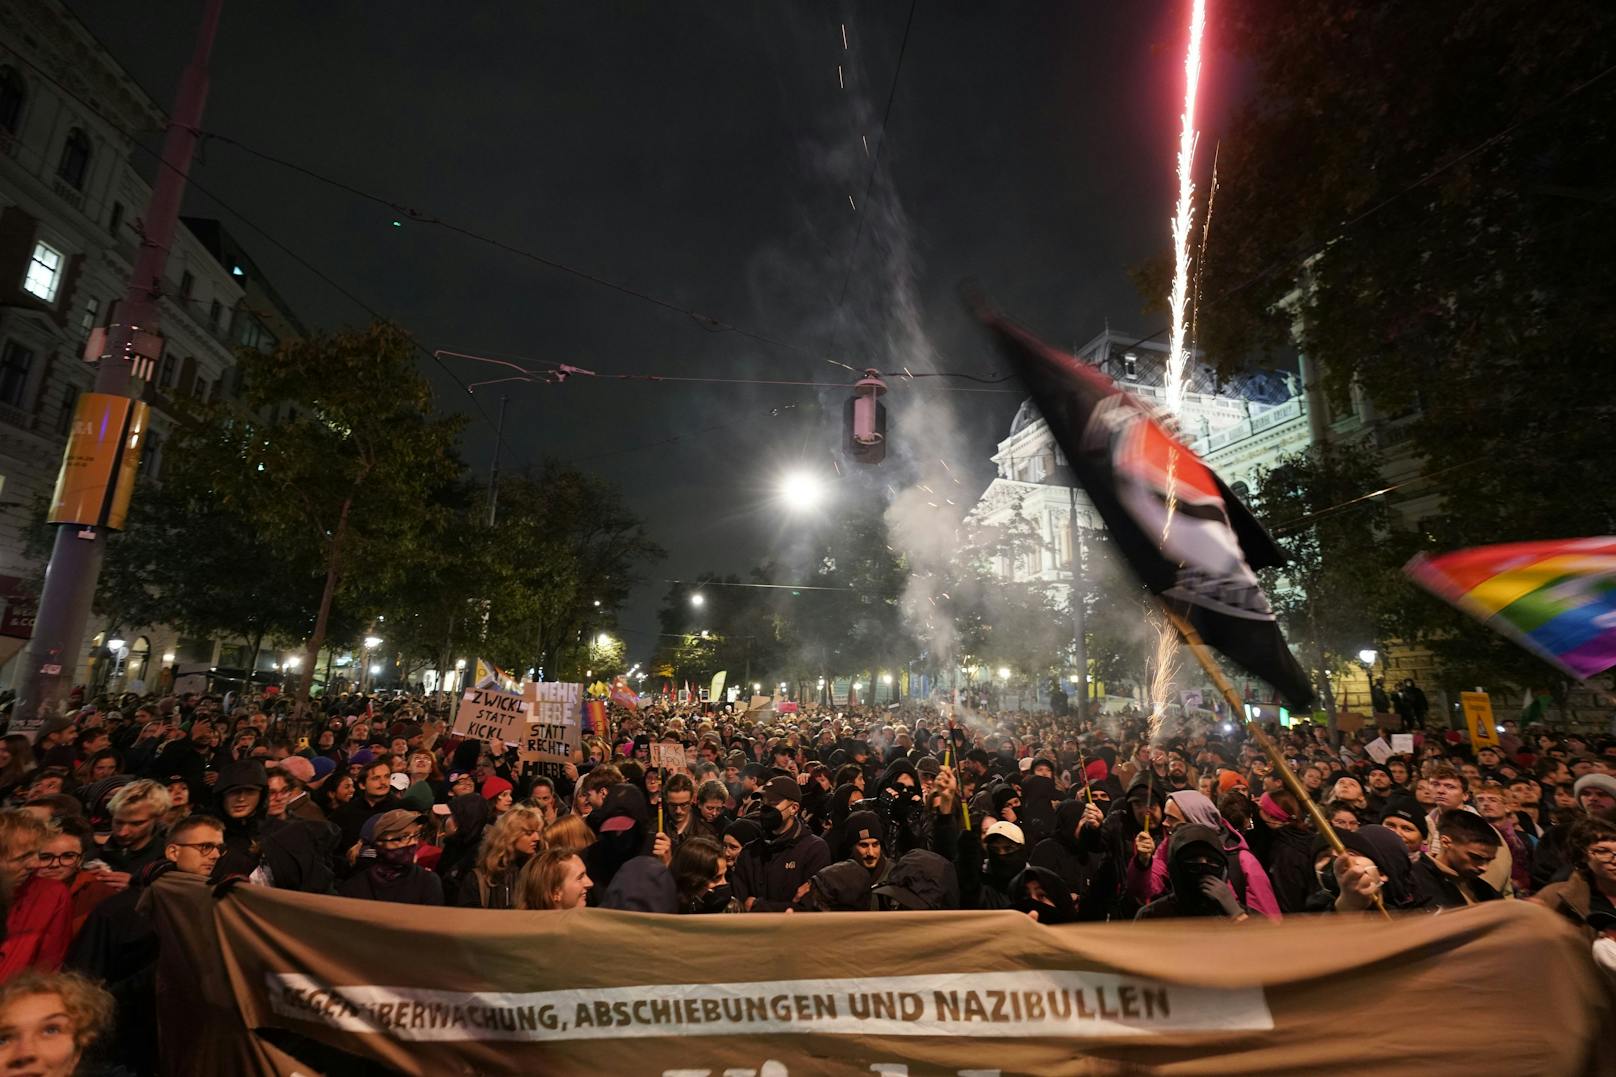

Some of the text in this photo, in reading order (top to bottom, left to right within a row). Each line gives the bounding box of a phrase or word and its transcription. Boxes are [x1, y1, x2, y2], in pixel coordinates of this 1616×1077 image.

[472, 691, 524, 713] ZWICKL
[536, 683, 579, 704] MEHR
[476, 709, 516, 726] STATT
[467, 722, 503, 741] KICKL
[530, 724, 566, 740] STATT
[527, 739, 570, 757] RECHTE
[575, 992, 835, 1028] ABSCHIEBUNGEN
[848, 991, 925, 1023] UND
[935, 985, 1170, 1025] NAZIBULLEN
